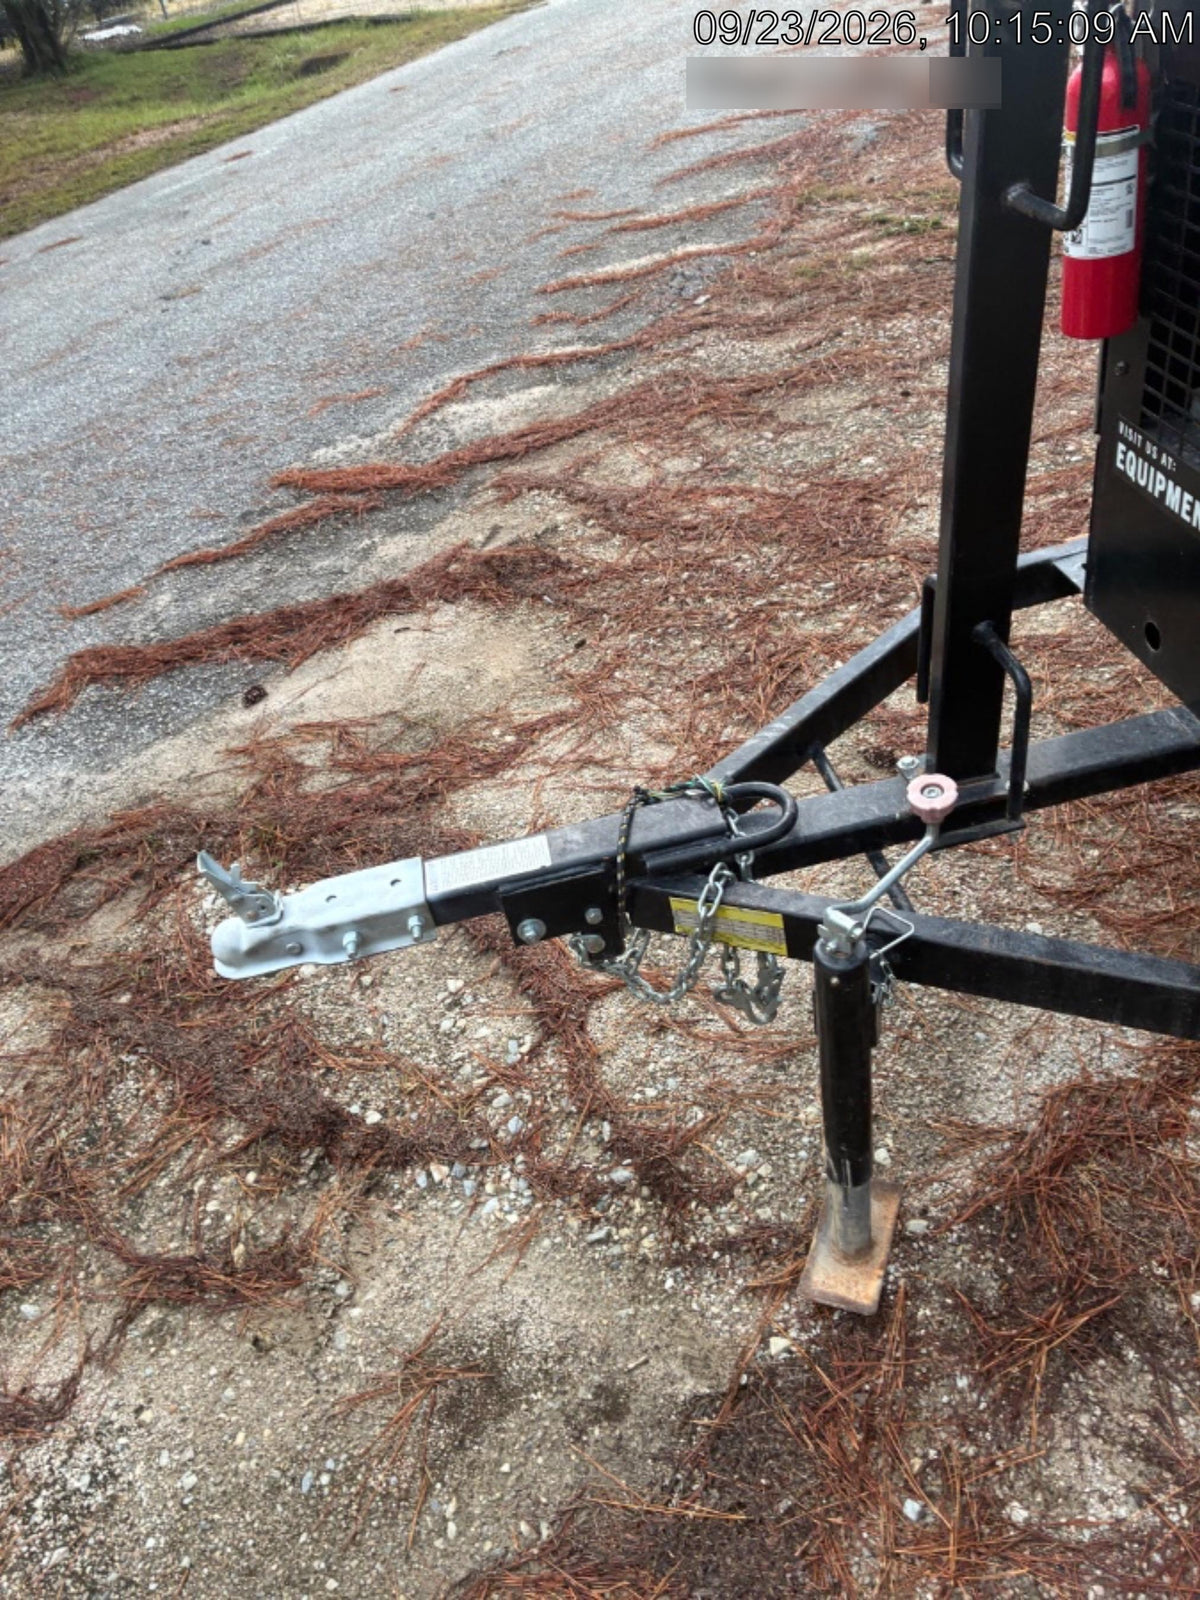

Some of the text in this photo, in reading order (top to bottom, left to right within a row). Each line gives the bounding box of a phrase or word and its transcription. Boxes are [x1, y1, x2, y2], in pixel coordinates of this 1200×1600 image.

[1118, 421, 1177, 472] VISIT US AT:
